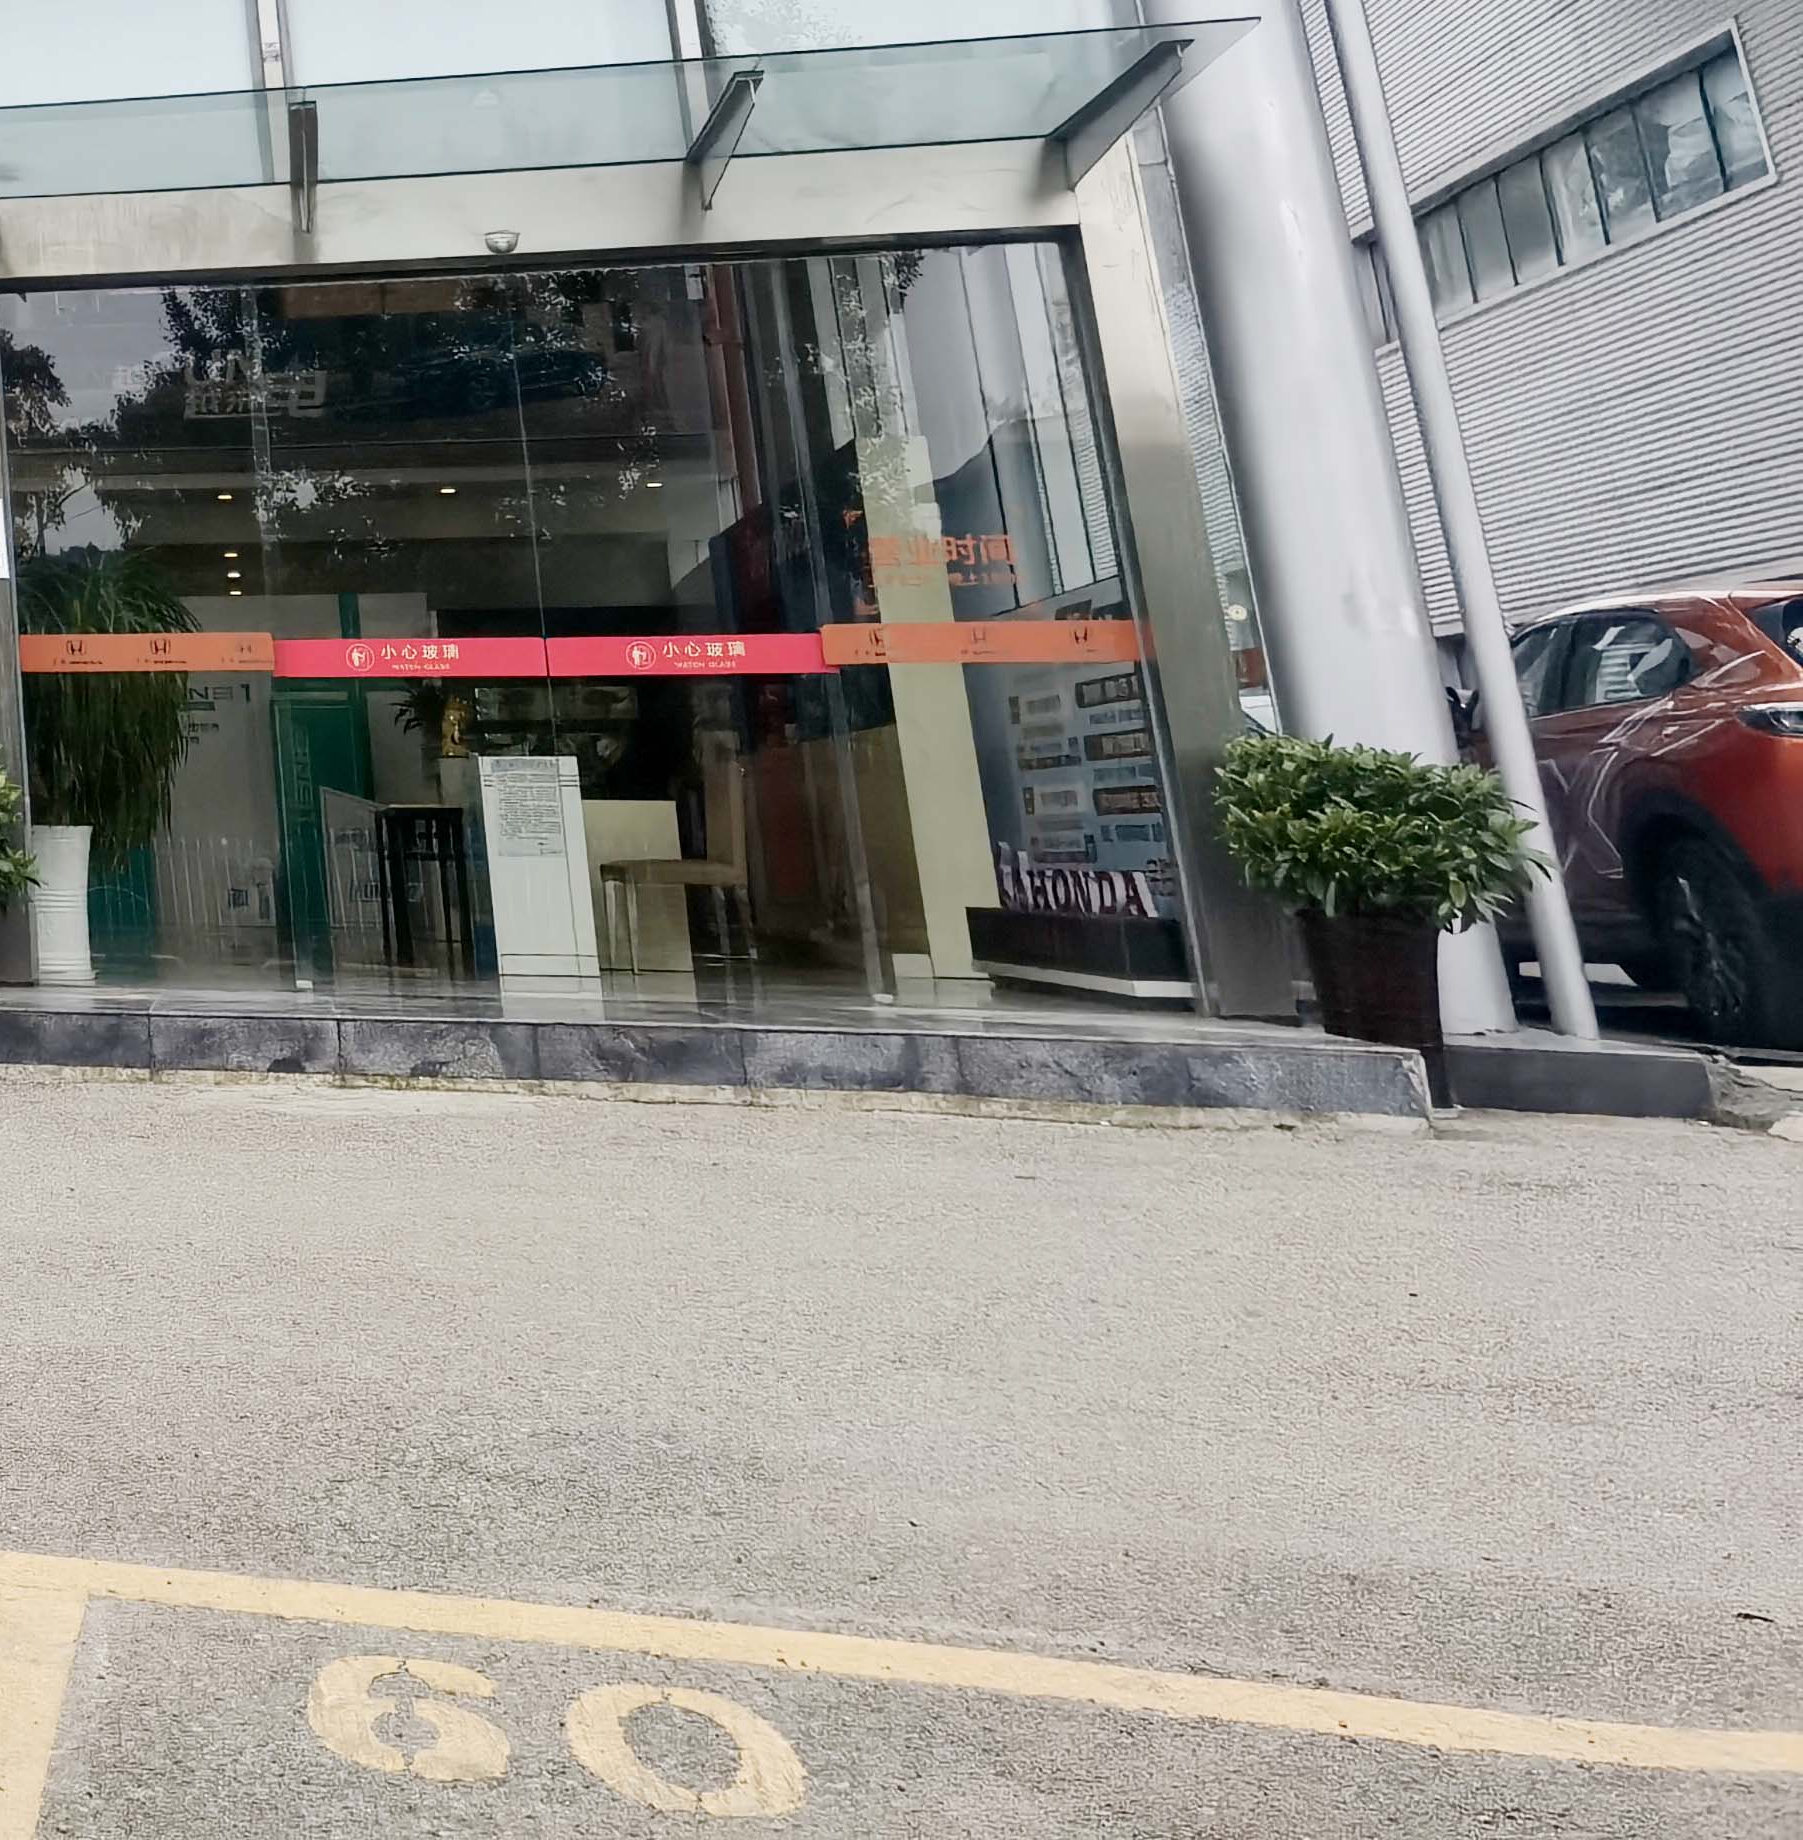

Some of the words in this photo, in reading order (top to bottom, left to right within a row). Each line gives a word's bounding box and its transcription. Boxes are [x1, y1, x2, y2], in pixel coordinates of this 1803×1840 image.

[380, 643, 460, 660] 小心玻璃
[662, 640, 746, 658] 小心玻璃
[306, 1653, 806, 1818] 60
